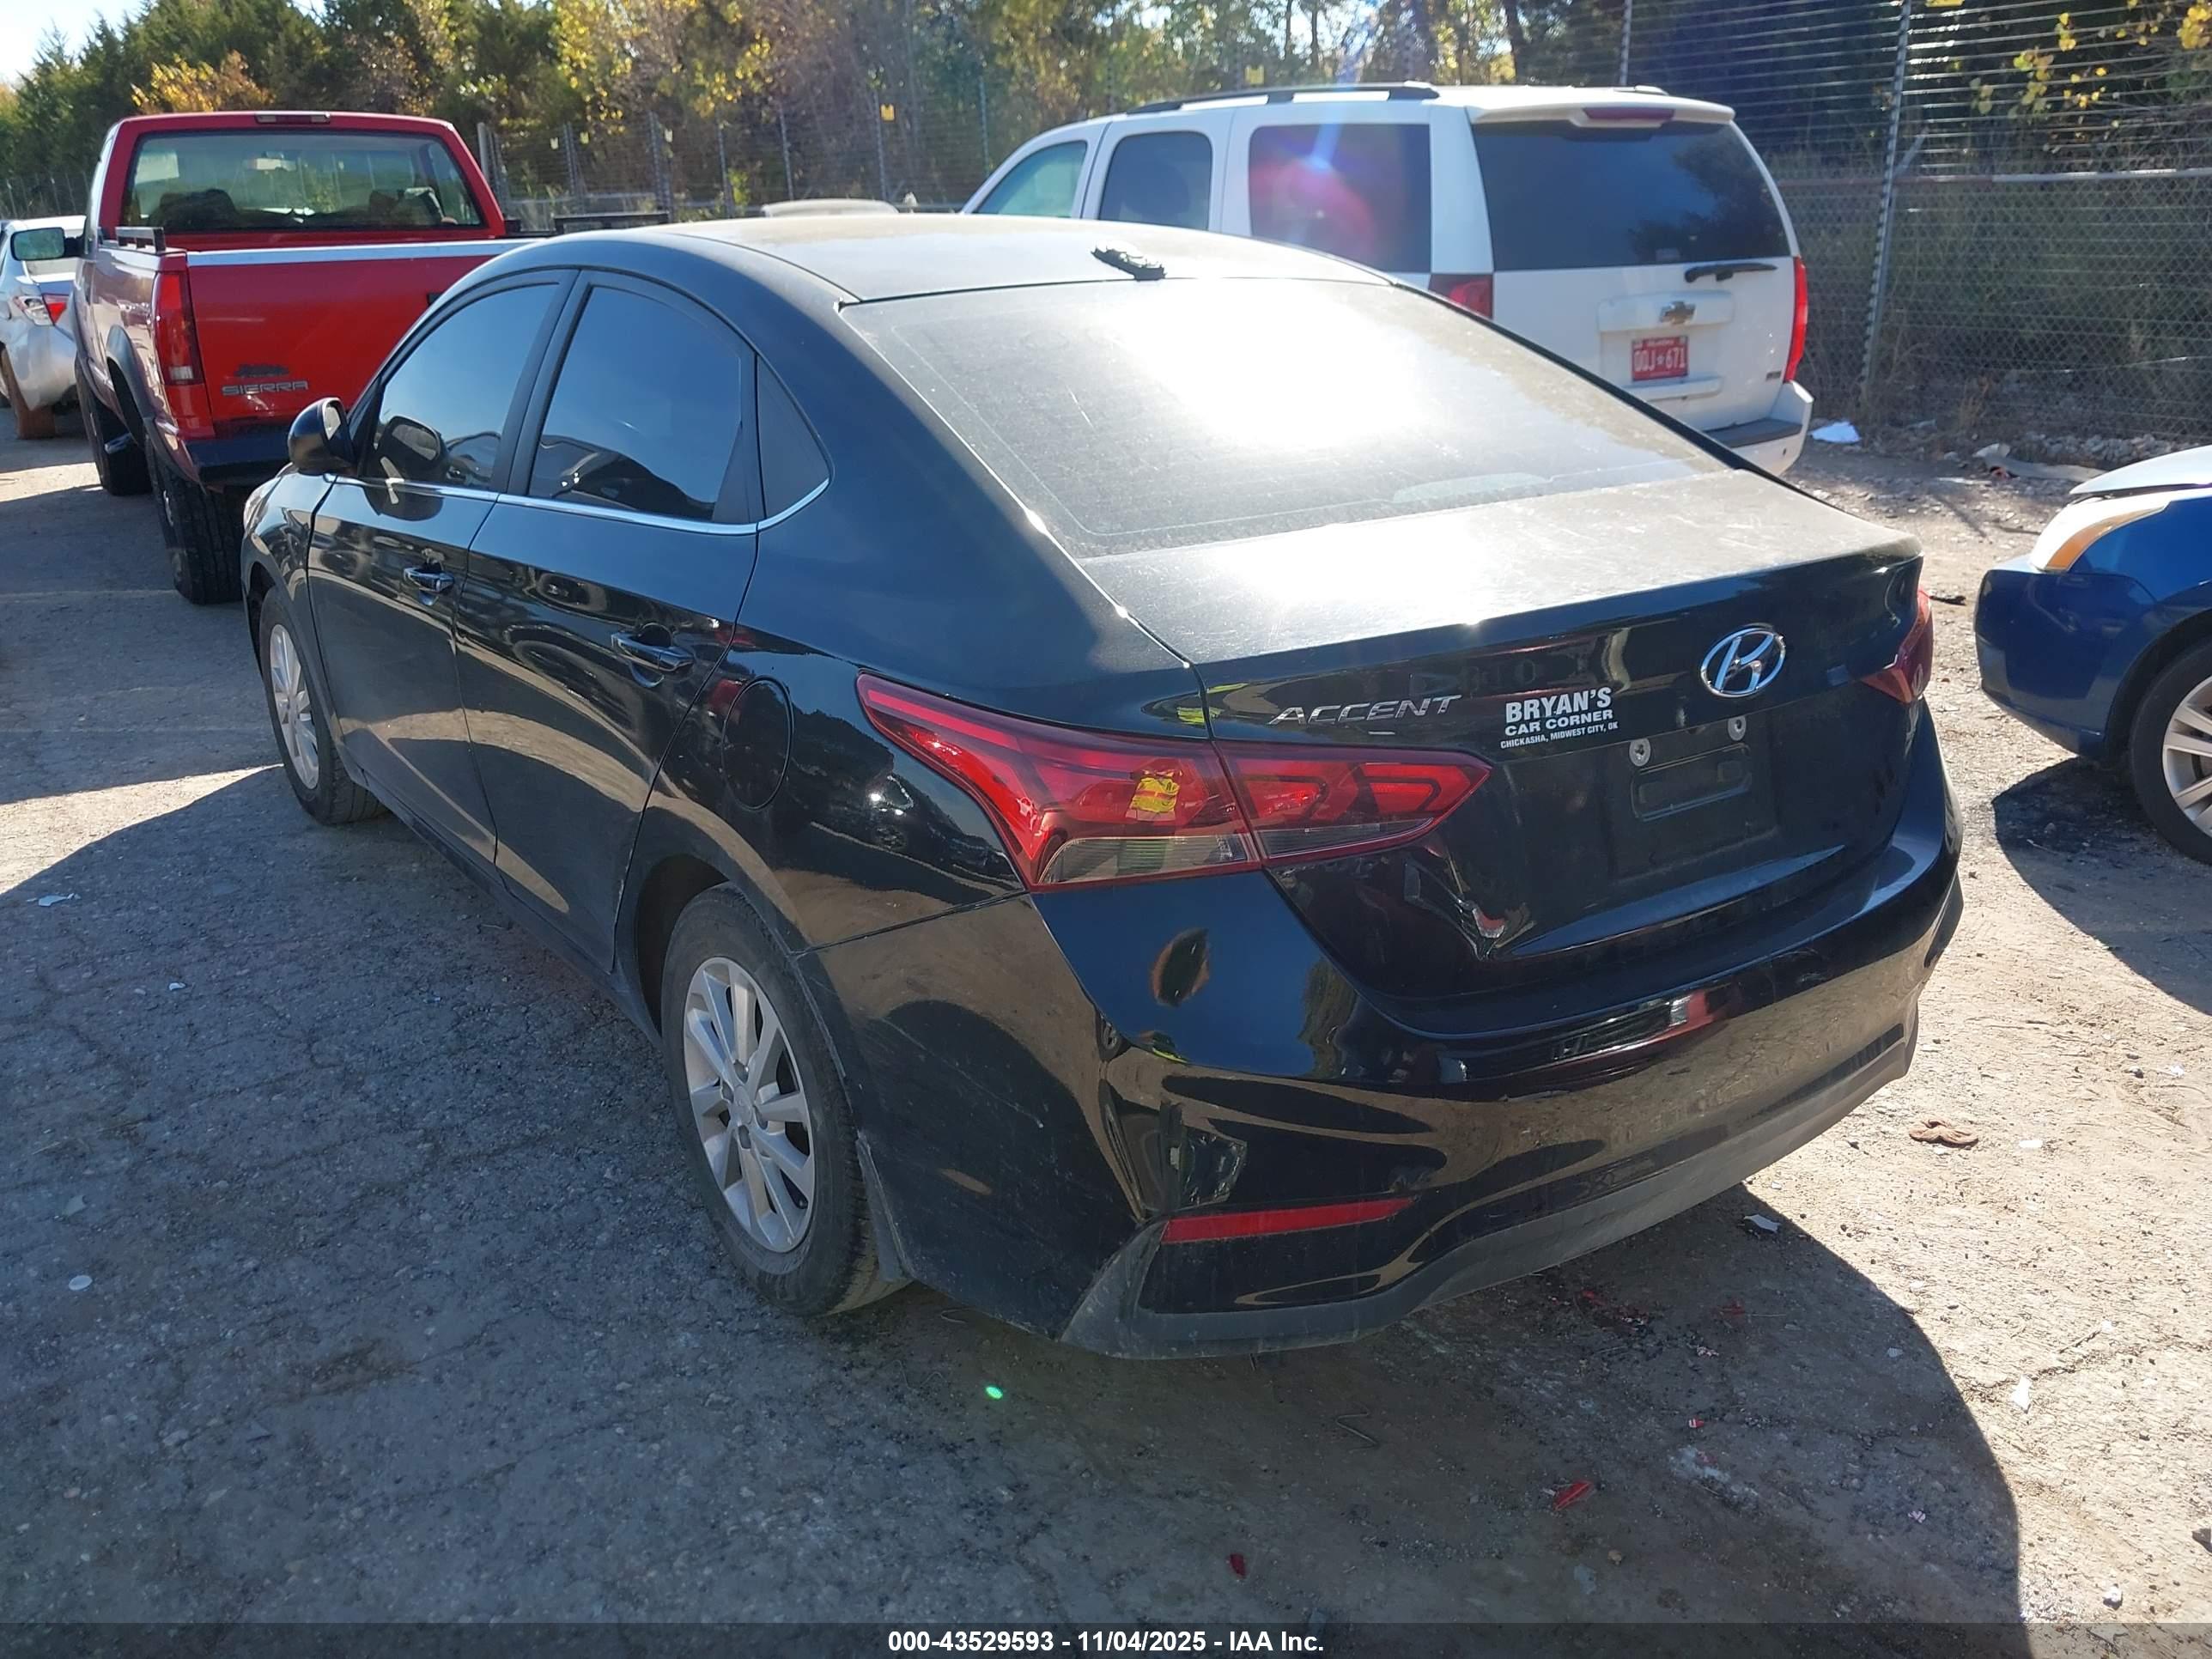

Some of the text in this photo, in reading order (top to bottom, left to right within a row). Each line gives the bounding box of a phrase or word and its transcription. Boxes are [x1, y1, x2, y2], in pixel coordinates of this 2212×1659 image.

[221, 380, 309, 396] SIERRA
[1267, 695, 1462, 726] ACCENT
[1505, 686, 1612, 723] BRYAN'S
[1500, 721, 1619, 750] CHICKASHA, MIDWEST CITY, OK
[1504, 708, 1613, 737] CAR CORNER
